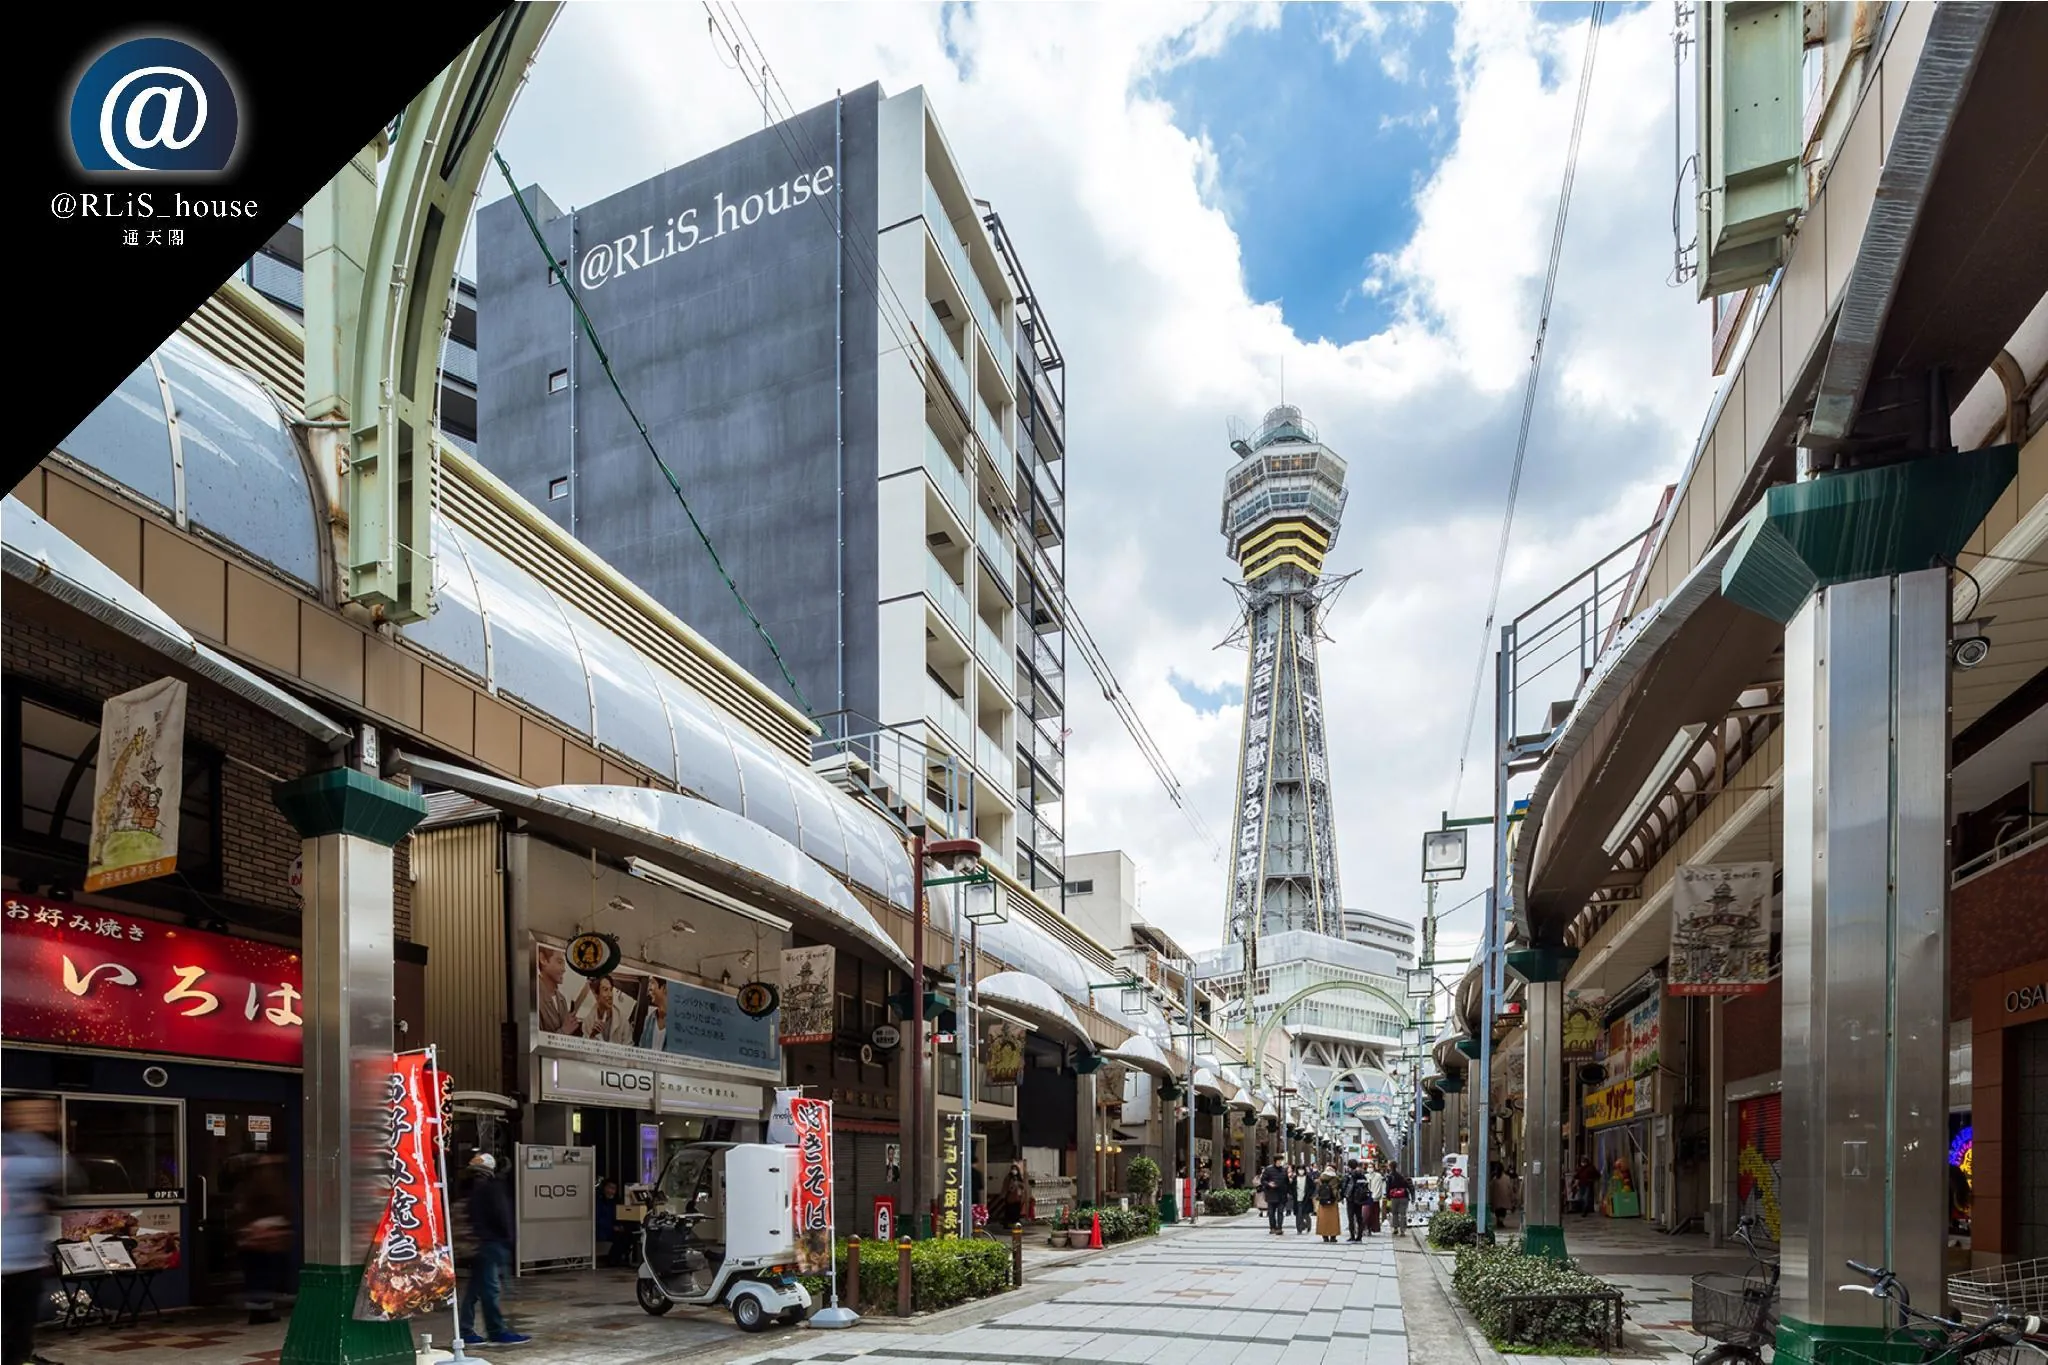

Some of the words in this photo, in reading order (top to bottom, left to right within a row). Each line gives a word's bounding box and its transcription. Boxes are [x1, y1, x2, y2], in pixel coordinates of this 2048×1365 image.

[579, 165, 835, 290] @RLiS_house
[1297, 632, 1327, 786] 通天閣
[1237, 637, 1276, 880] 社会に貢献する日立
[6, 900, 145, 942] お好み焼き
[62, 954, 304, 1027] いろは
[2005, 984, 2048, 1013] OSA
[600, 1069, 652, 1093] IQOS
[154, 1190, 179, 1199] OPEN
[534, 1184, 578, 1199] IQOS
